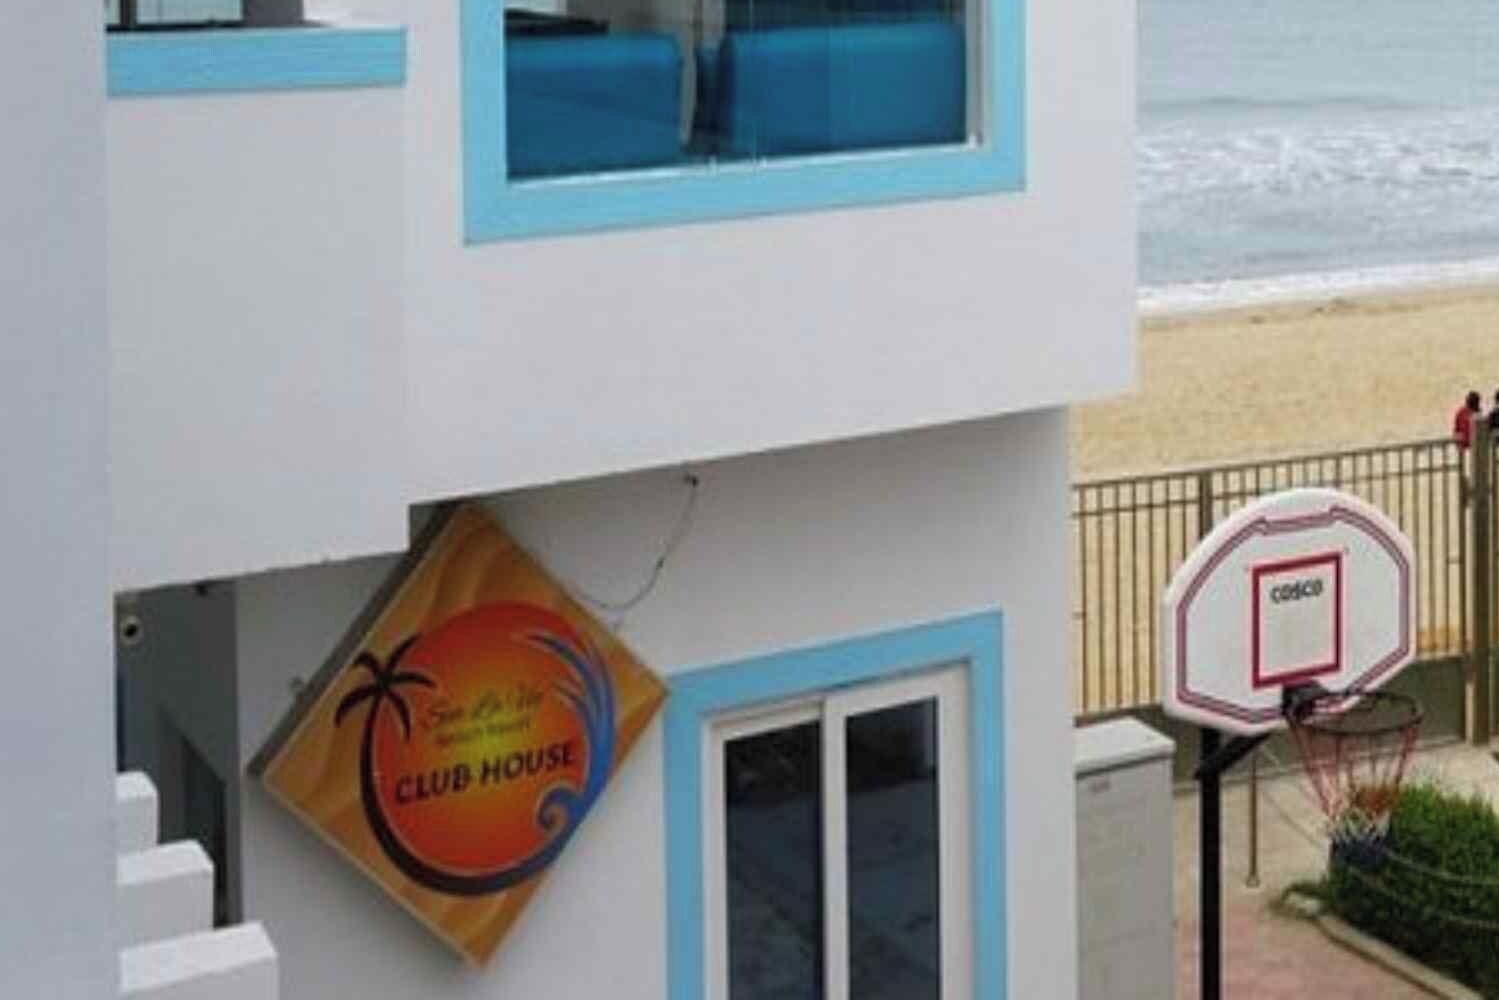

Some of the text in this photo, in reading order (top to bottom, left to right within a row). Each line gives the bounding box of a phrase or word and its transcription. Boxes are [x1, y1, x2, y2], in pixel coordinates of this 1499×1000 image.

[1270, 579, 1323, 604] COSCO
[396, 742, 575, 804] CLUB HOUSE
